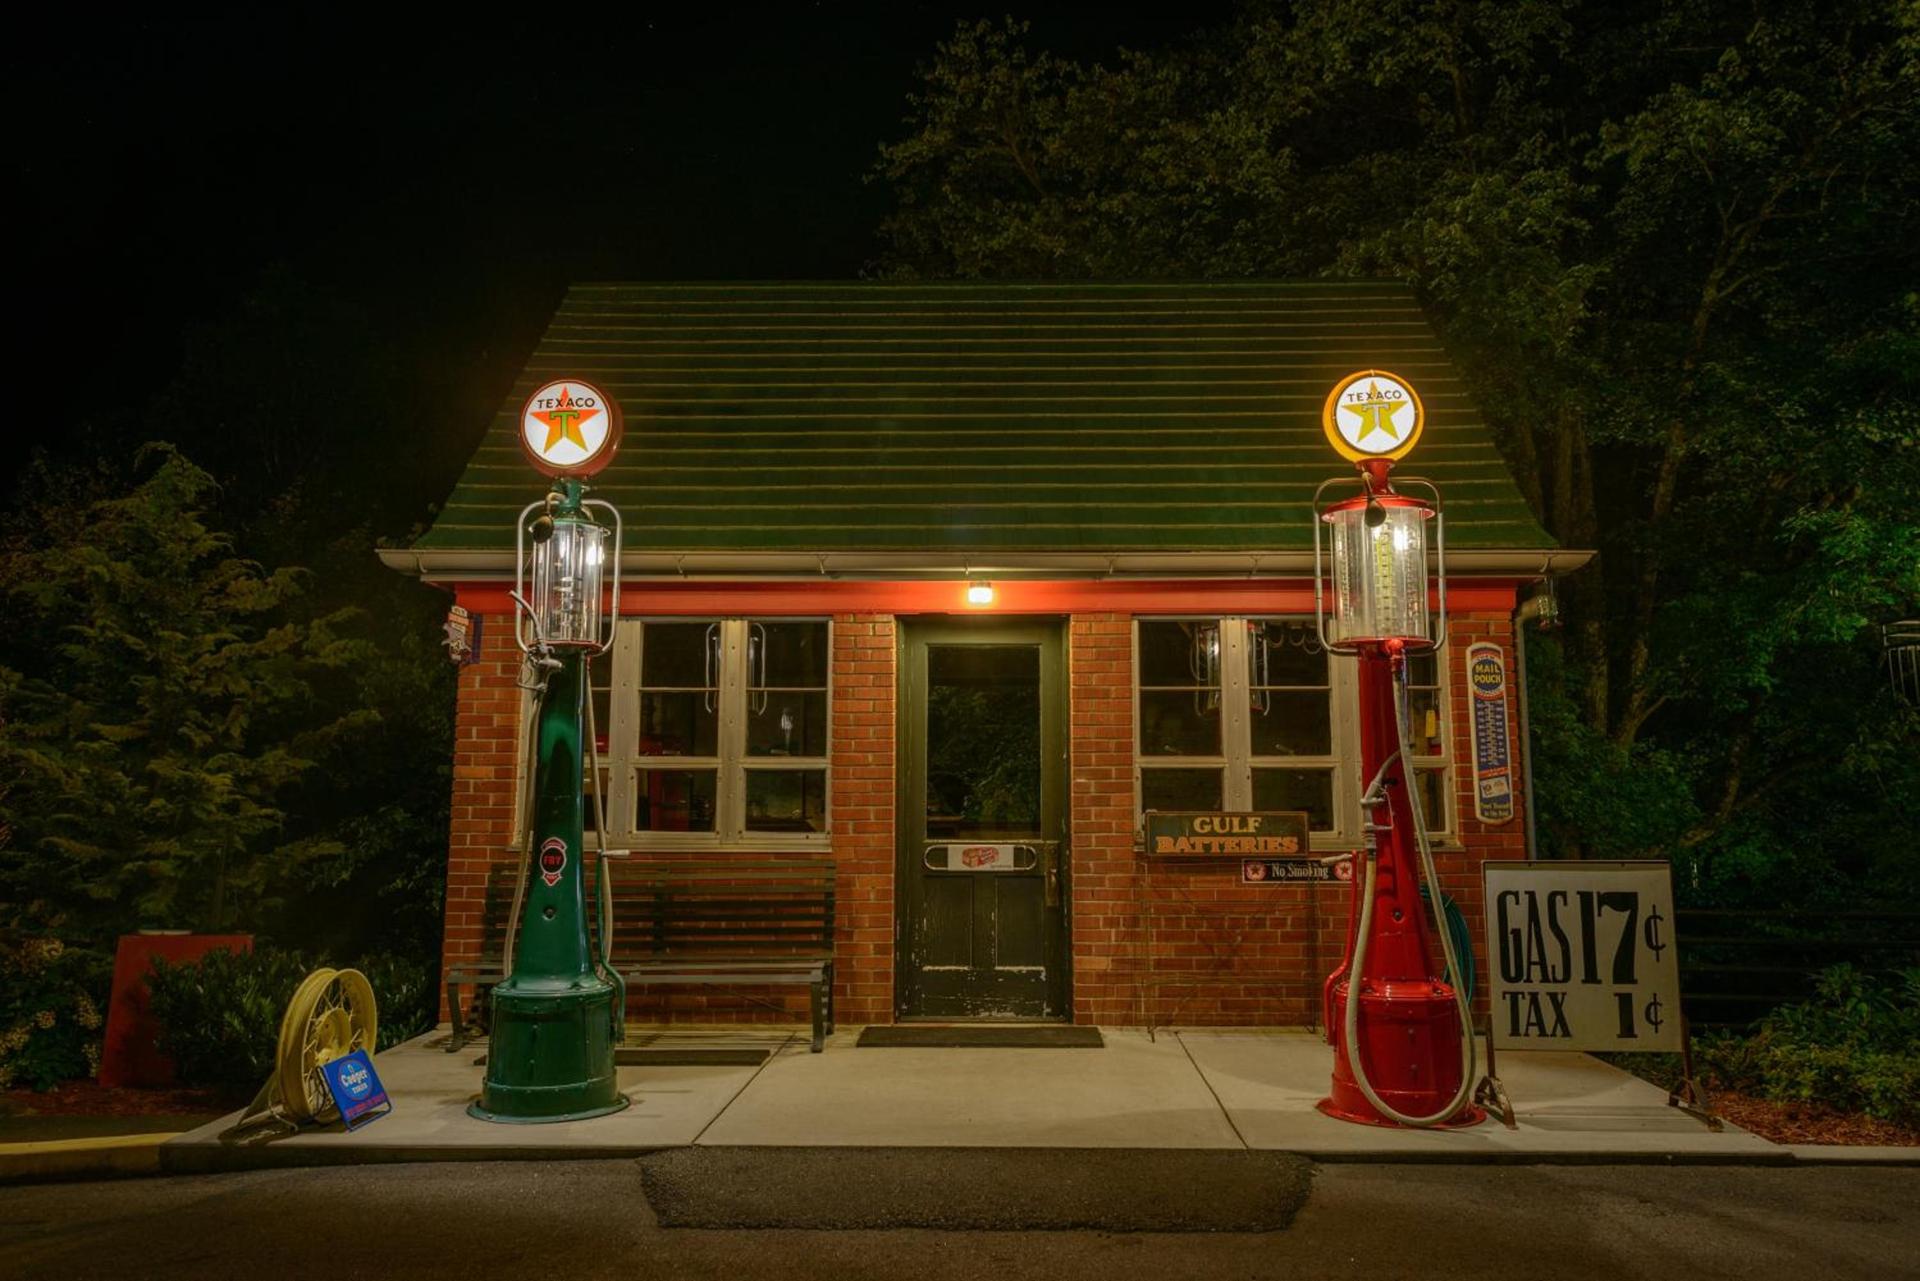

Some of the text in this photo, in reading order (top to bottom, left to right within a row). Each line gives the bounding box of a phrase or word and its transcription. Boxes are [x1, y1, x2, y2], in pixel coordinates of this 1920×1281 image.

[537, 397, 595, 409] TEXACO
[1347, 390, 1402, 402] TEXACO
[1475, 664, 1500, 673] MAIL
[1474, 674, 1501, 684] POUCH
[1193, 816, 1263, 833] GULF
[1156, 836, 1299, 853] BATTERIES
[1272, 862, 1329, 879] No Smoking
[1497, 890, 1572, 984] GAS
[1502, 991, 1572, 1037] TAX
[341, 1069, 368, 1088] Cooper
